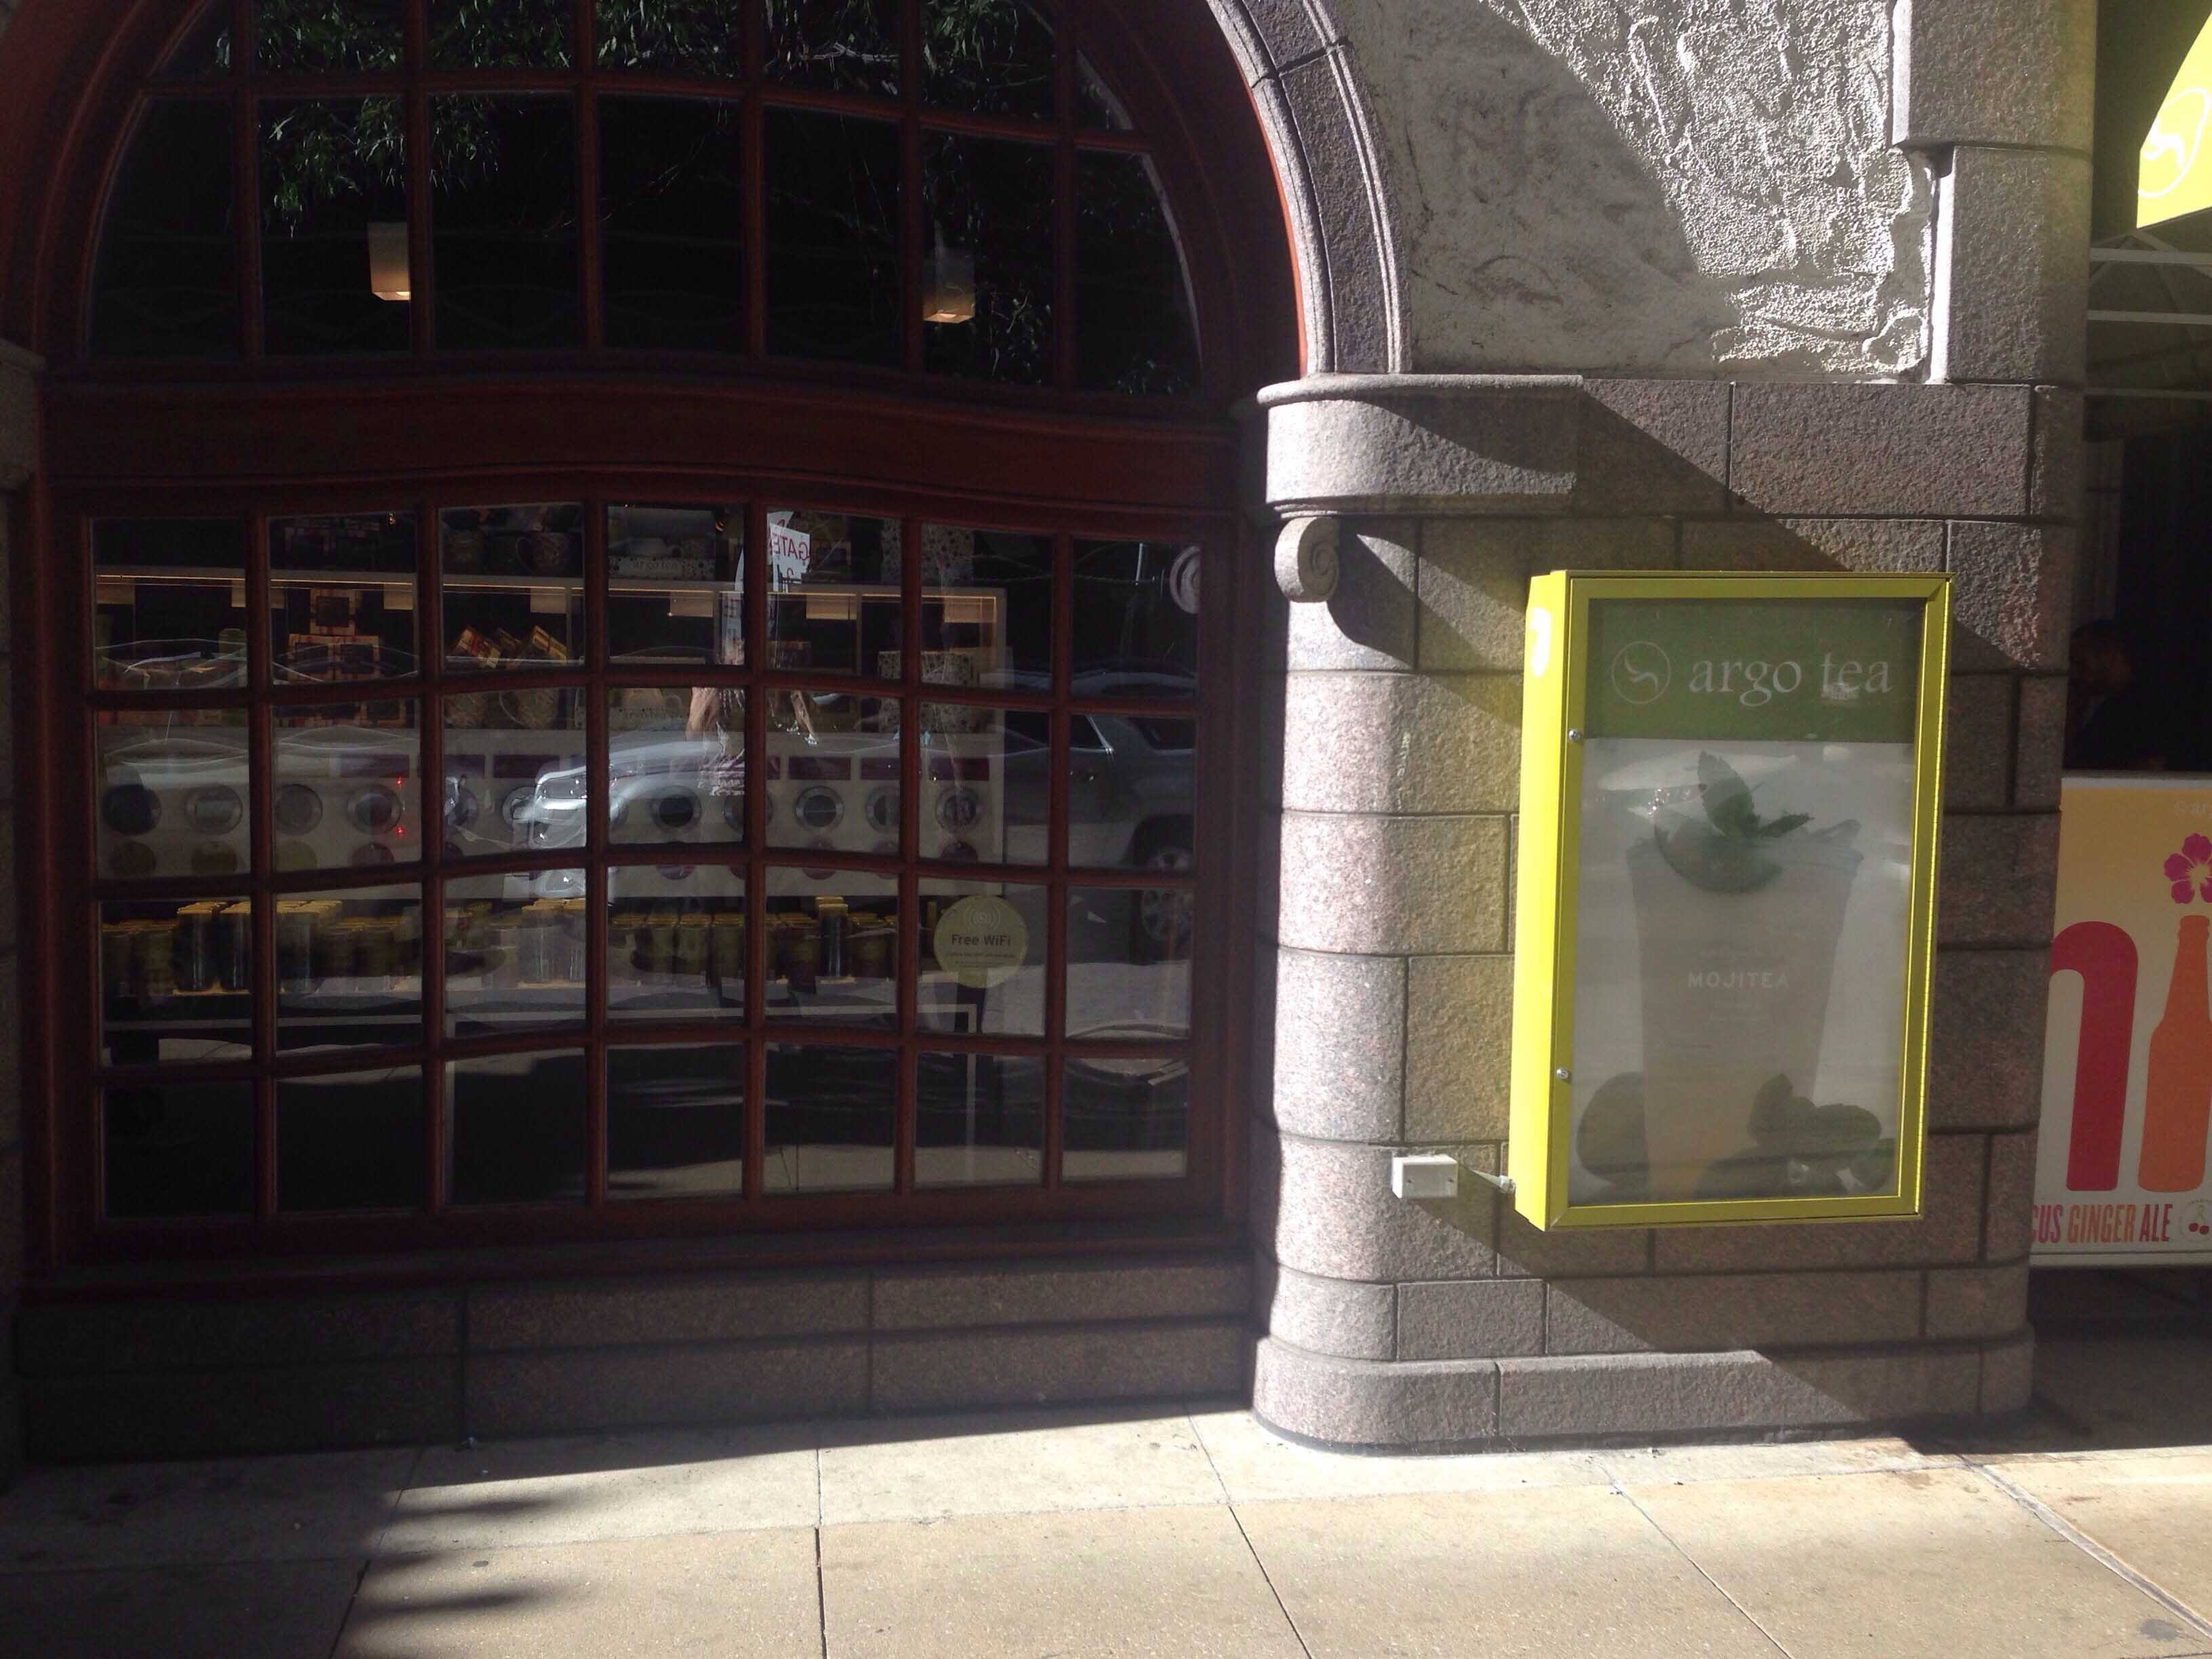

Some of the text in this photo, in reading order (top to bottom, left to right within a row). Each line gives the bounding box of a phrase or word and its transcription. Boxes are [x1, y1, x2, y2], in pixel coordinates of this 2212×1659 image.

[1688, 652, 1892, 708] argo tea
[951, 933, 1012, 947] Free WiFi
[1688, 971, 1790, 988] MOJITEA
[2068, 1204, 2137, 1243] GINGER
[2139, 1203, 2173, 1242] ALE
